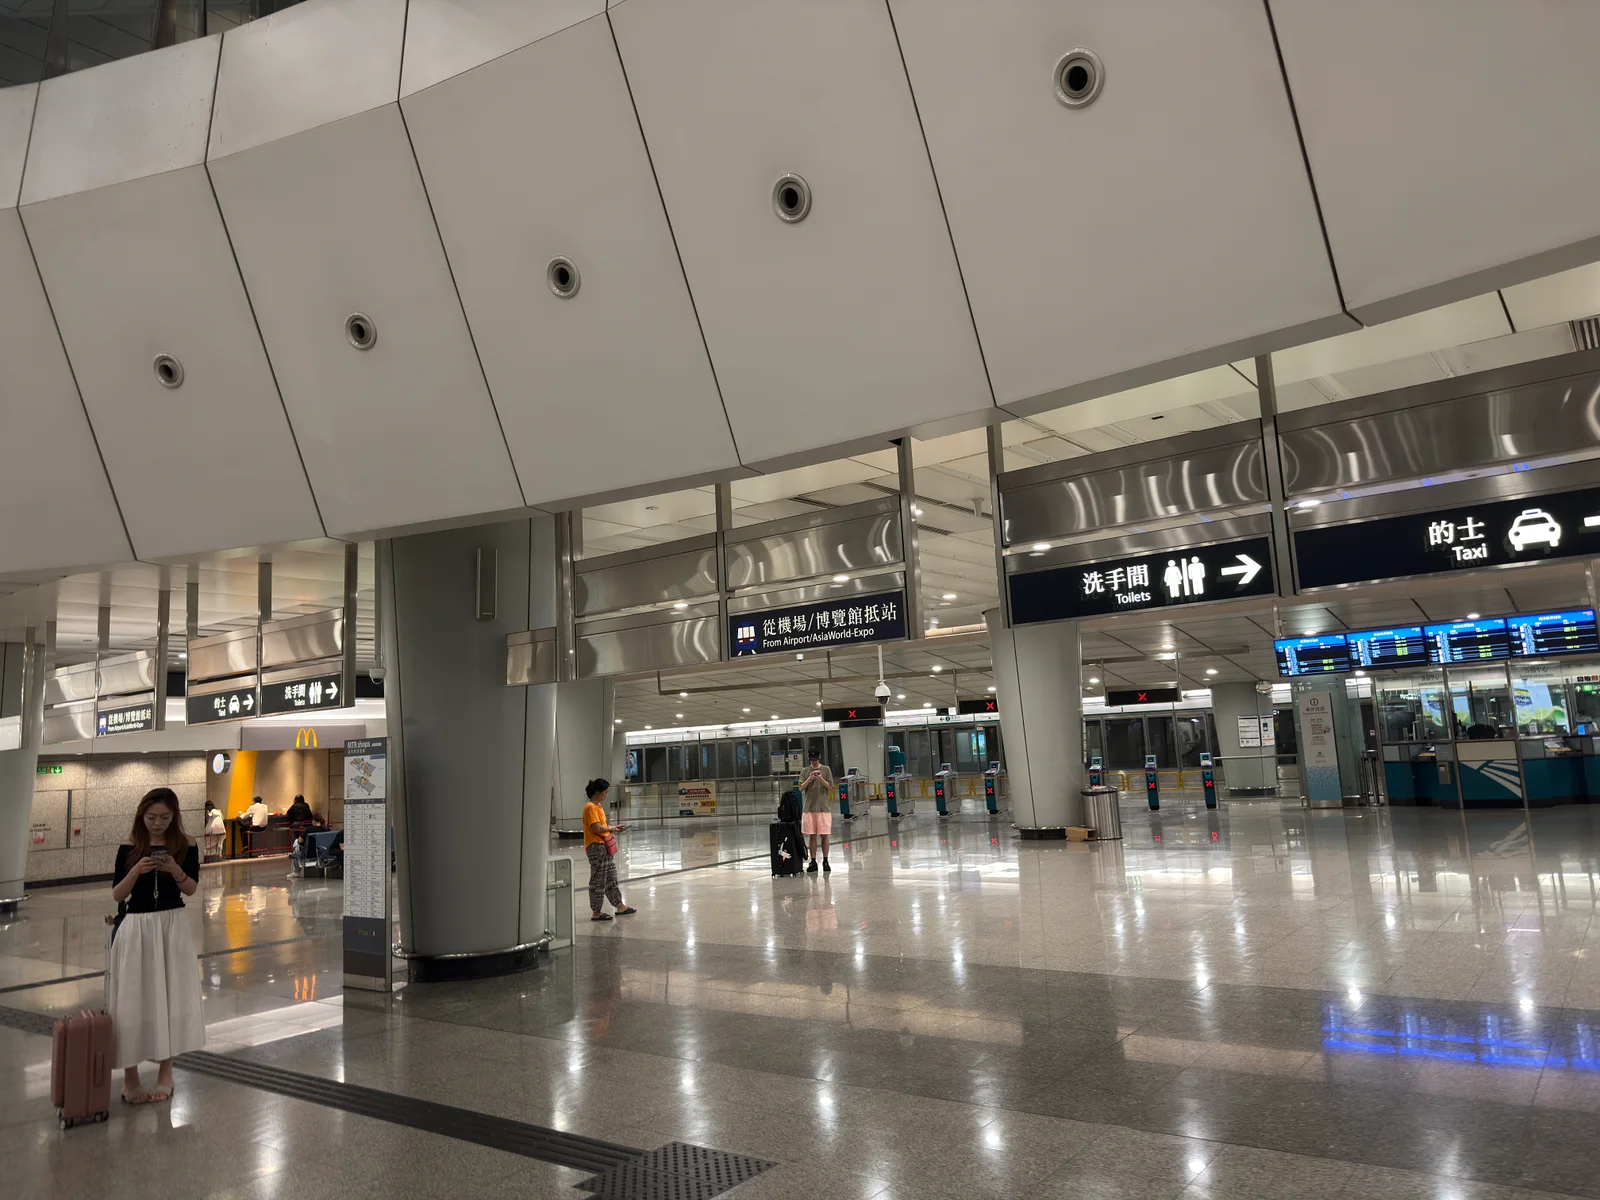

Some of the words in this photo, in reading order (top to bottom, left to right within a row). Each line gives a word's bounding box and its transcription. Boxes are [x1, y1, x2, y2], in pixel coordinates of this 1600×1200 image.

[1428, 516, 1485, 546] 的士
[1451, 543, 1488, 561] Taxi
[1082, 564, 1149, 595] 洗手間
[1115, 592, 1151, 604] Toilets
[763, 602, 897, 637] 從機場/博覽館抵站
[763, 639, 782, 648] From
[783, 627, 875, 646] Airport/AsiaWorld-Expo
[284, 683, 306, 700] 洗手間
